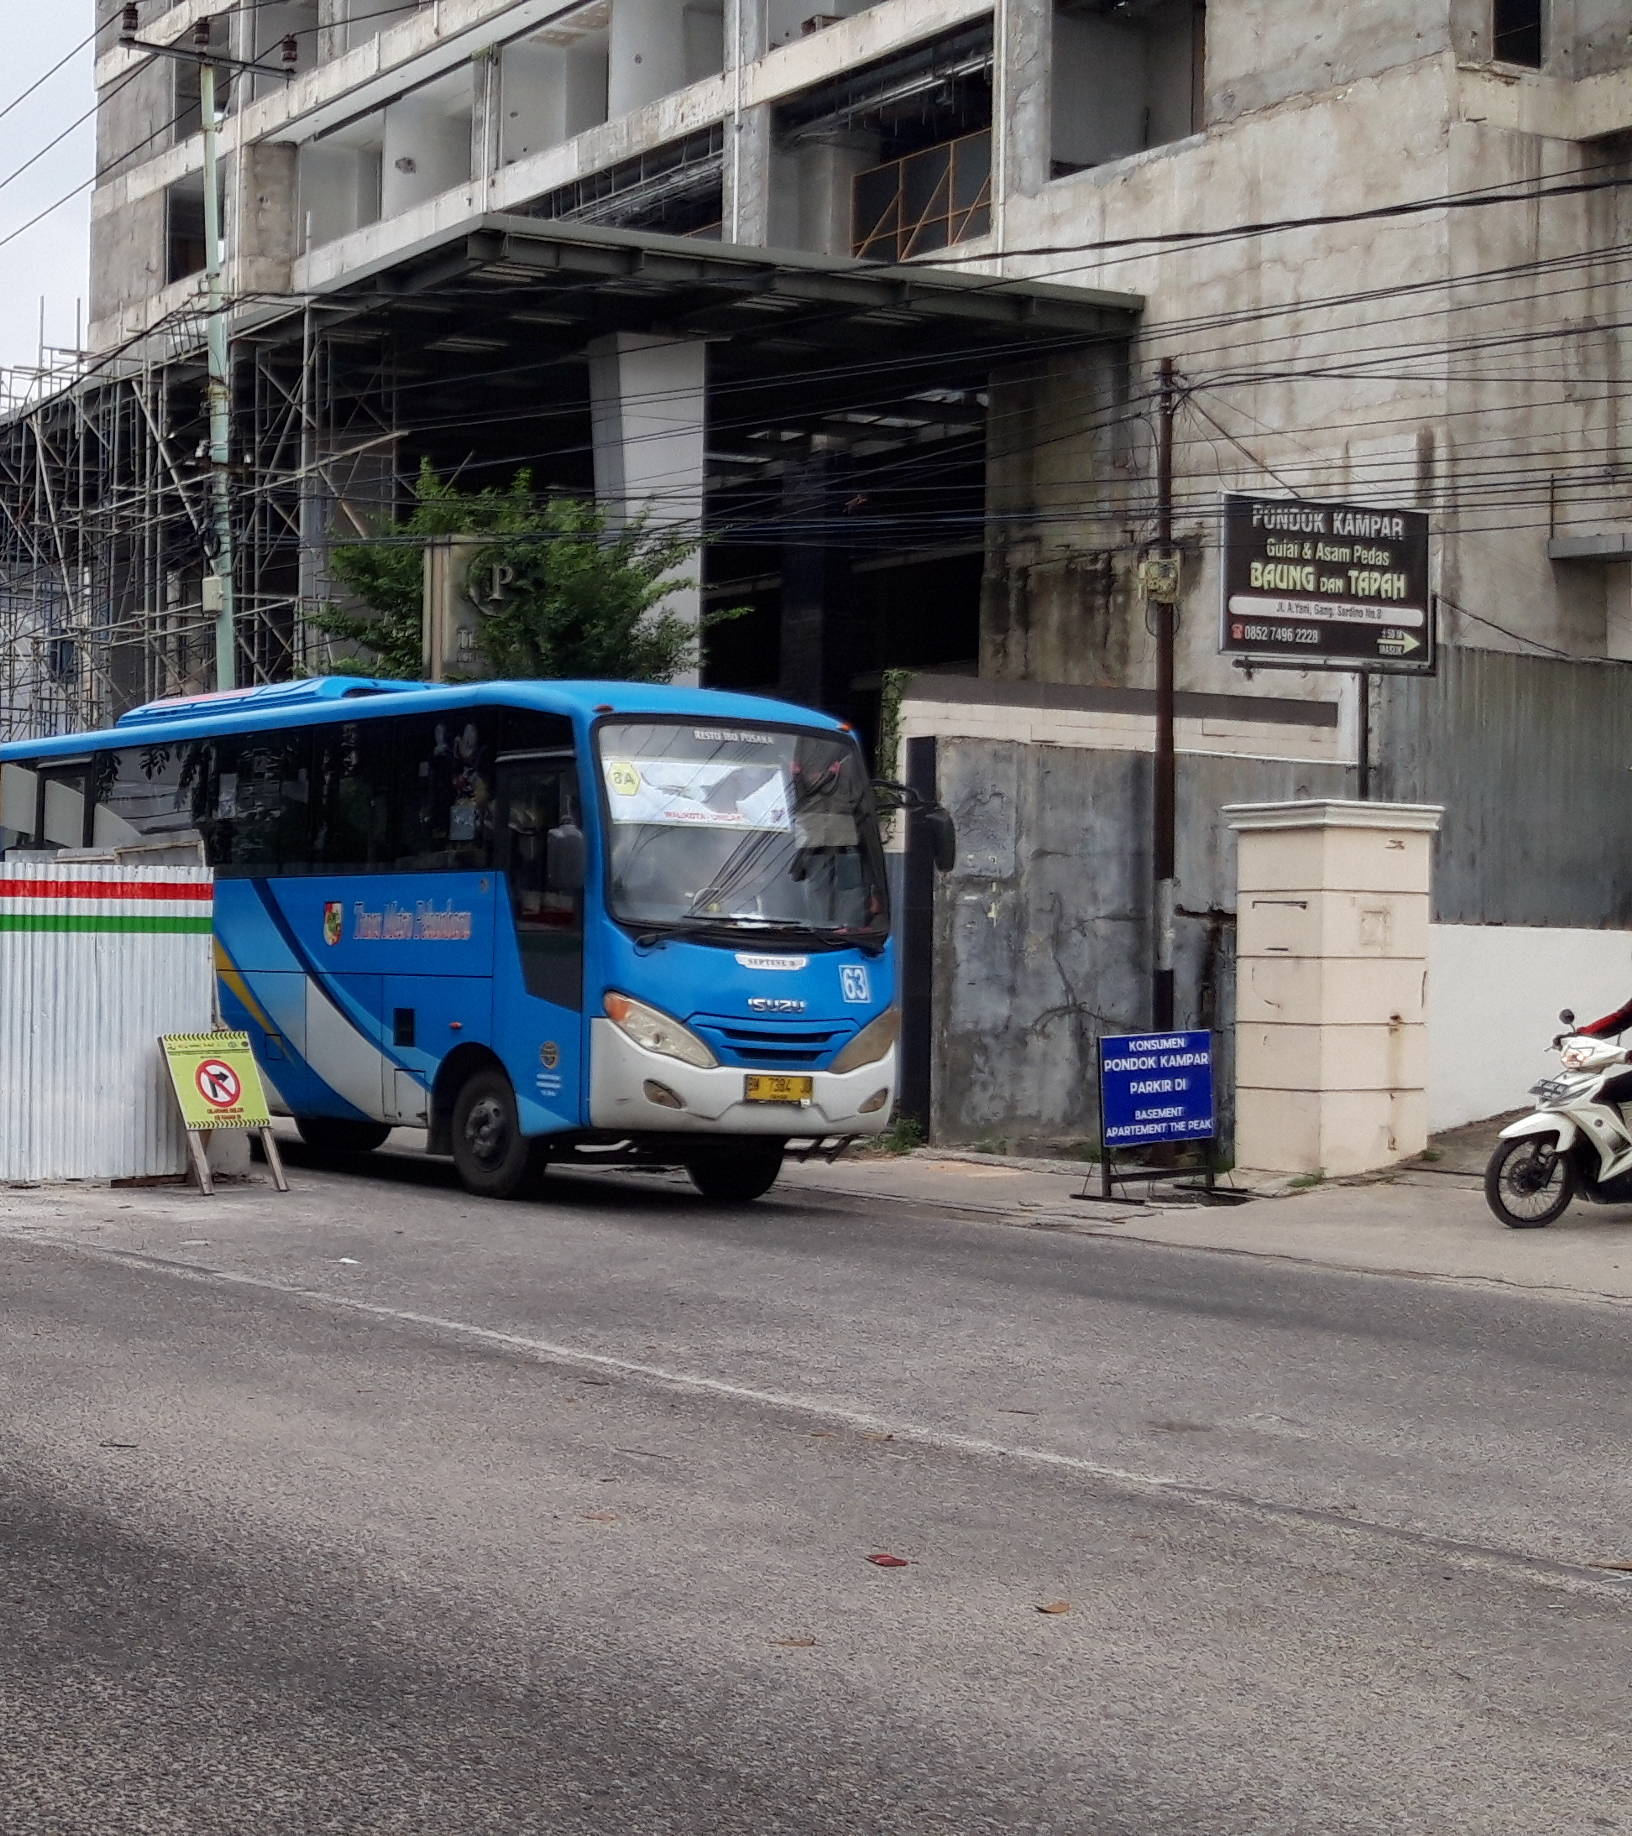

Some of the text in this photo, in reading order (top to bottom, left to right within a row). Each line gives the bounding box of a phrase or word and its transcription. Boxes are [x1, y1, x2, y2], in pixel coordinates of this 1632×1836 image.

[1252, 504, 1404, 540] PONDOK KAMPAR
[1266, 538, 1390, 566] Gulai & Asam Pedas
[1250, 562, 1406, 600] BAUNG DAN TAPAH
[1244, 625, 1318, 644] 0852 7496 2228
[842, 967, 867, 1000] 63
[748, 998, 806, 1013] ISUZU
[1128, 1037, 1185, 1052] KONSUMEN
[1104, 1052, 1209, 1072] PONDOK KAMPAR
[1130, 1078, 1187, 1094] PARKIR DI
[1135, 1106, 1184, 1120] BASEMENT
[1106, 1120, 1212, 1138] APARTEMENT THE PEAK
